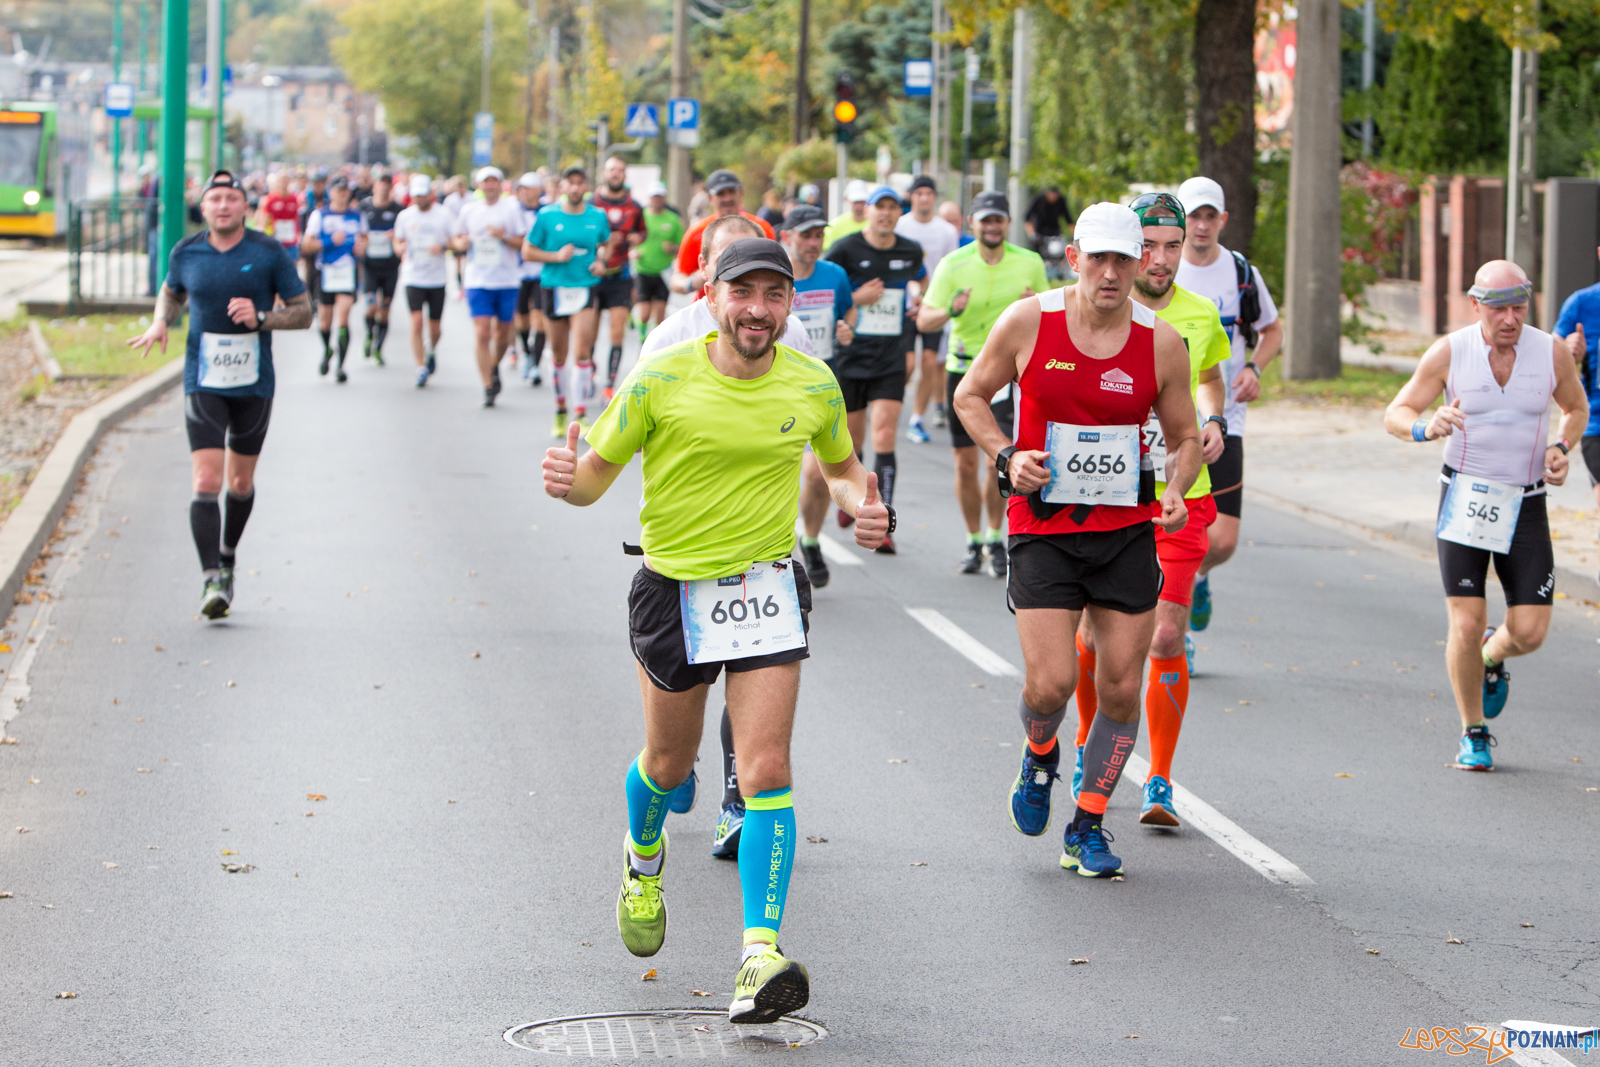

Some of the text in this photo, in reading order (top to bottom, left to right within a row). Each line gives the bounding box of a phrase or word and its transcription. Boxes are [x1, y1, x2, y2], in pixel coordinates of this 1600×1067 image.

[673, 100, 695, 125] P
[213, 352, 251, 367] 6847
[1055, 361, 1076, 371] asics
[1100, 380, 1133, 391] LOKATOR
[1067, 453, 1126, 474] 6656
[1077, 474, 1115, 482] KRZYSZTOF
[1466, 501, 1500, 523] 545
[729, 575, 741, 583] PKO
[711, 594, 780, 624] 6016
[734, 621, 761, 631] Michał
[1095, 734, 1135, 791] Kalenji
